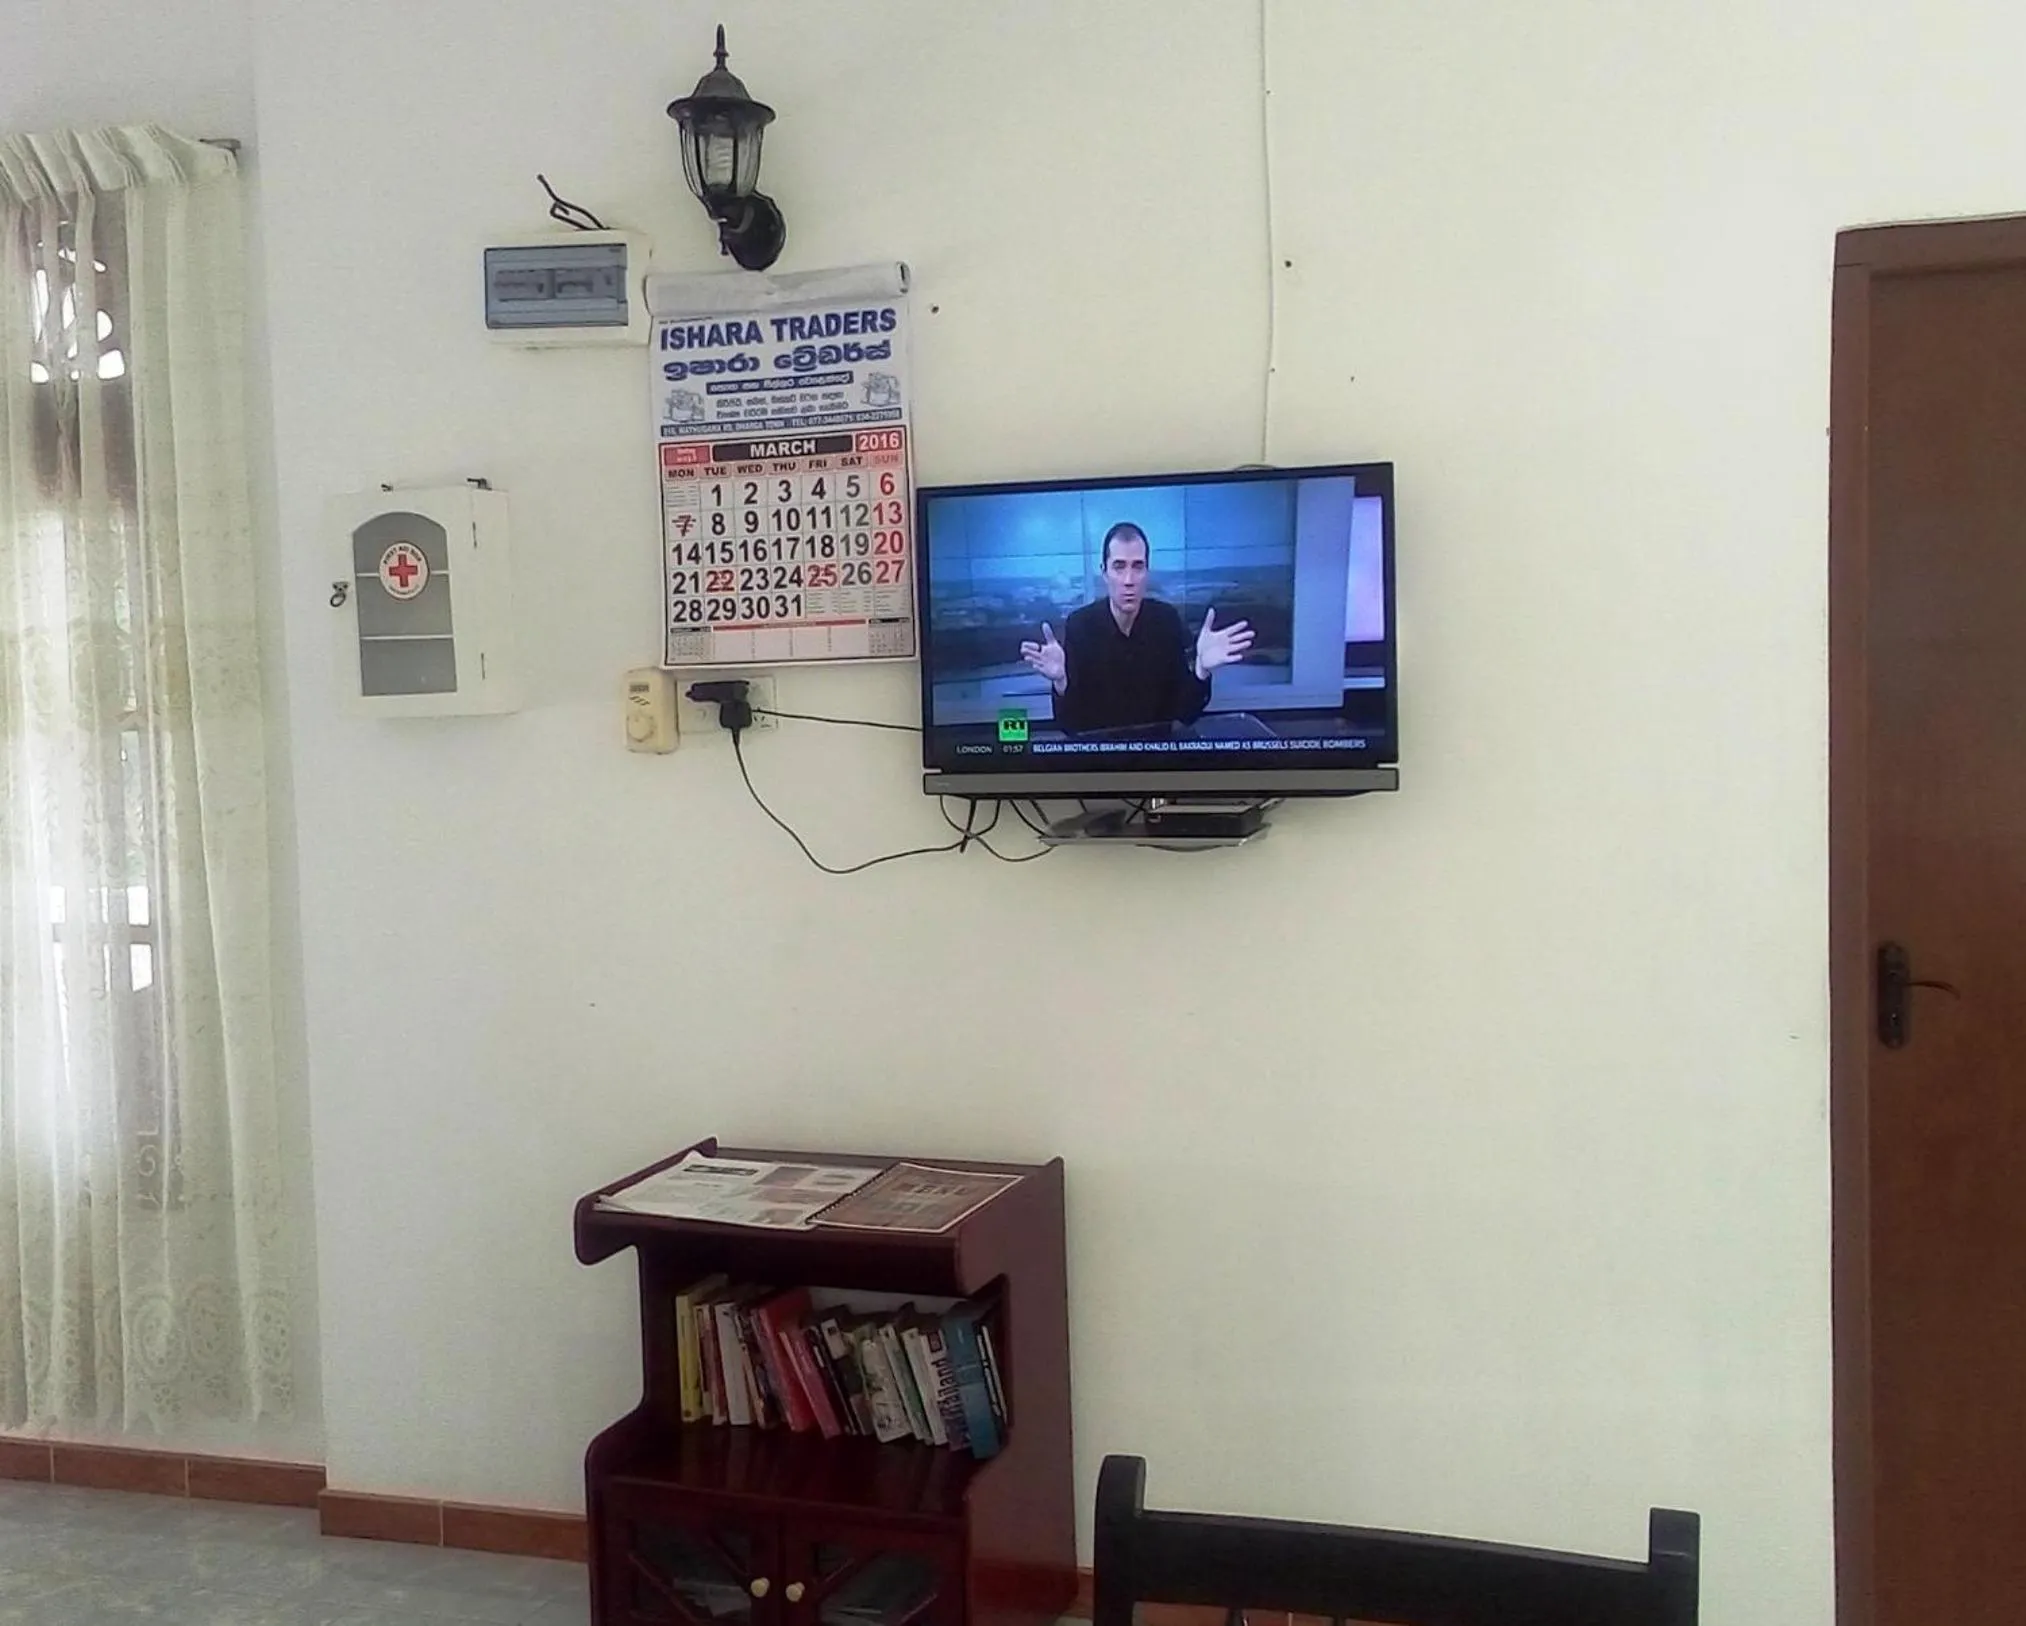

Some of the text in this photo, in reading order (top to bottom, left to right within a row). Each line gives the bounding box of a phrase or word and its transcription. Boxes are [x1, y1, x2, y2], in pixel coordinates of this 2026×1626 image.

[661, 308, 897, 351] ISHARA TRADERS
[750, 440, 816, 457] MARCH
[859, 432, 899, 450] 2016
[668, 455, 898, 477] MON TUE WED THU FRI SAT SUN
[712, 484, 721, 506] 1
[744, 482, 758, 505] 2
[778, 480, 791, 502] 3
[811, 477, 826, 499] 4
[847, 475, 860, 498] 5
[881, 473, 894, 495] 6
[712, 513, 725, 535] 8
[745, 511, 758, 533] 9
[772, 508, 800, 532] 10
[807, 506, 830, 529] 11
[840, 503, 869, 526] 12
[874, 501, 902, 525] 13
[672, 531, 903, 565] 14 15 16 17 18 19 20
[673, 560, 904, 594] 21 22 23 24 25 26 27
[673, 599, 702, 622] 28
[707, 598, 736, 621] 29
[741, 596, 770, 619] 30
[775, 594, 801, 617] 31
[956, 744, 993, 754] LONDON
[1033, 743, 1063, 752] BELGIAN
[1064, 743, 1098, 752] BROTHERS
[1128, 742, 1143, 751] AND
[1144, 742, 1169, 751] KHALID
[1215, 741, 1240, 750] NAMED
[1242, 741, 1251, 749] AS
[1252, 740, 1288, 749] BRUSSELS
[1289, 740, 1320, 749] SUICIDE
[1322, 739, 1366, 749] BOMBERS
